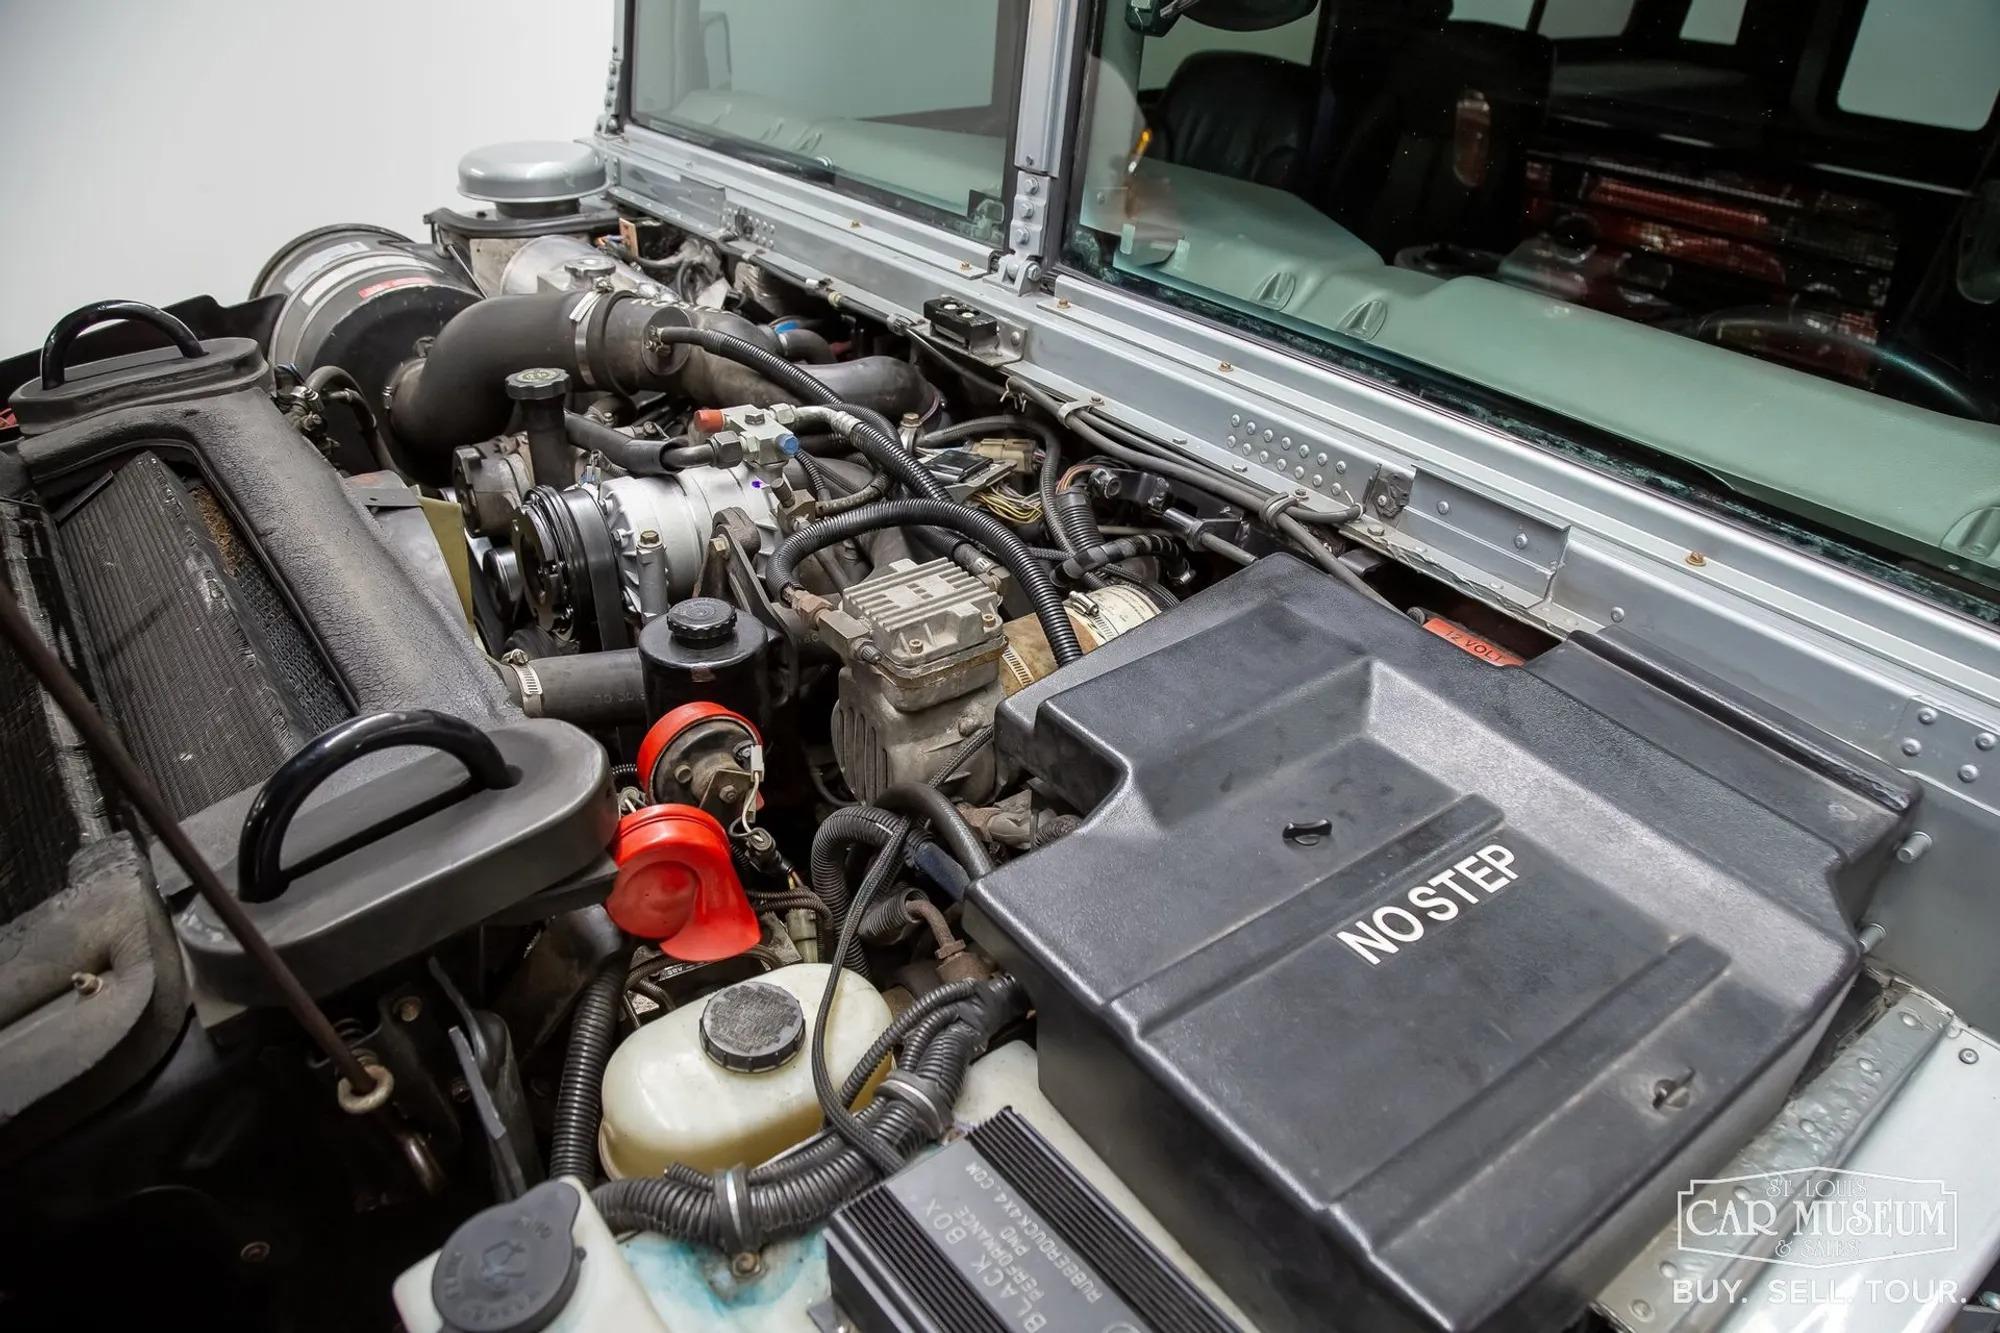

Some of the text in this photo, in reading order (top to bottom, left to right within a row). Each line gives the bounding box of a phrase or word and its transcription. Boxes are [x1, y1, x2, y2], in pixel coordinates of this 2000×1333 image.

[1336, 844, 1519, 965] NO STEP
[924, 1199, 1047, 1333] BLACK BOX
[955, 1205, 1045, 1302] PERFORMANCE
[965, 1161, 1103, 1304] RUBBERDUCK4X4.COM
